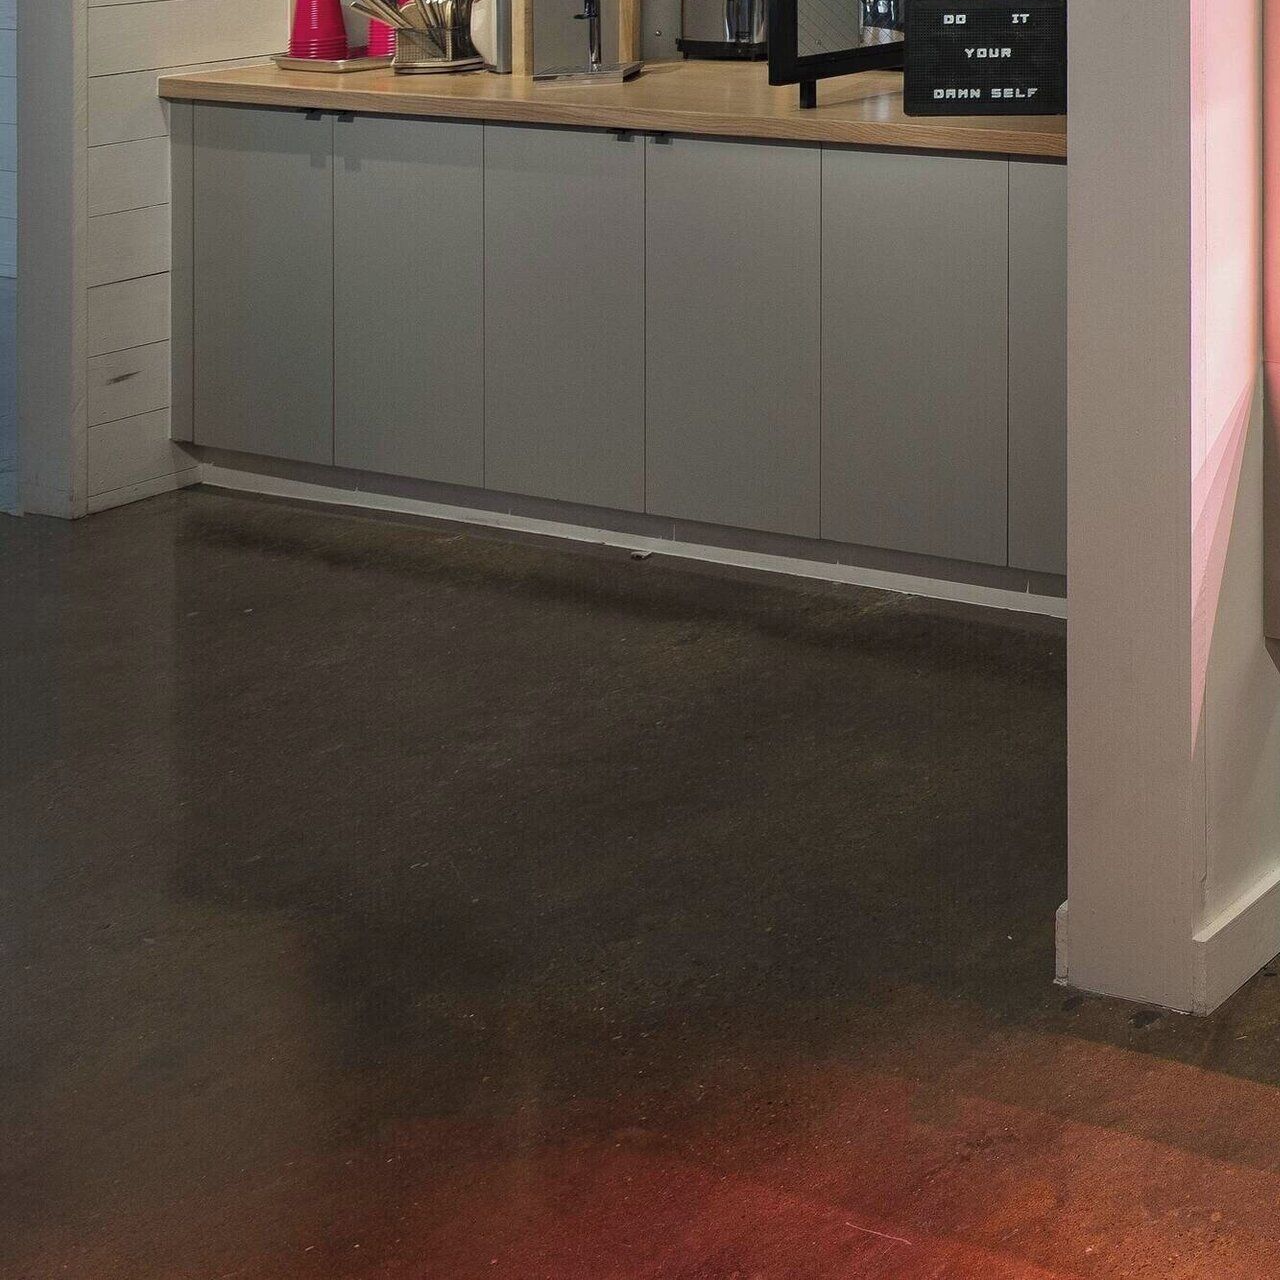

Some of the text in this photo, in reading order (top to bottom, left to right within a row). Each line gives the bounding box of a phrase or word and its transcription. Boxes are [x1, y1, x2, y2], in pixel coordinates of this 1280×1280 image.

[943, 13, 1030, 25] DO IT
[964, 47, 1012, 58] YOUR
[933, 88, 1038, 99] DAMN SELF
